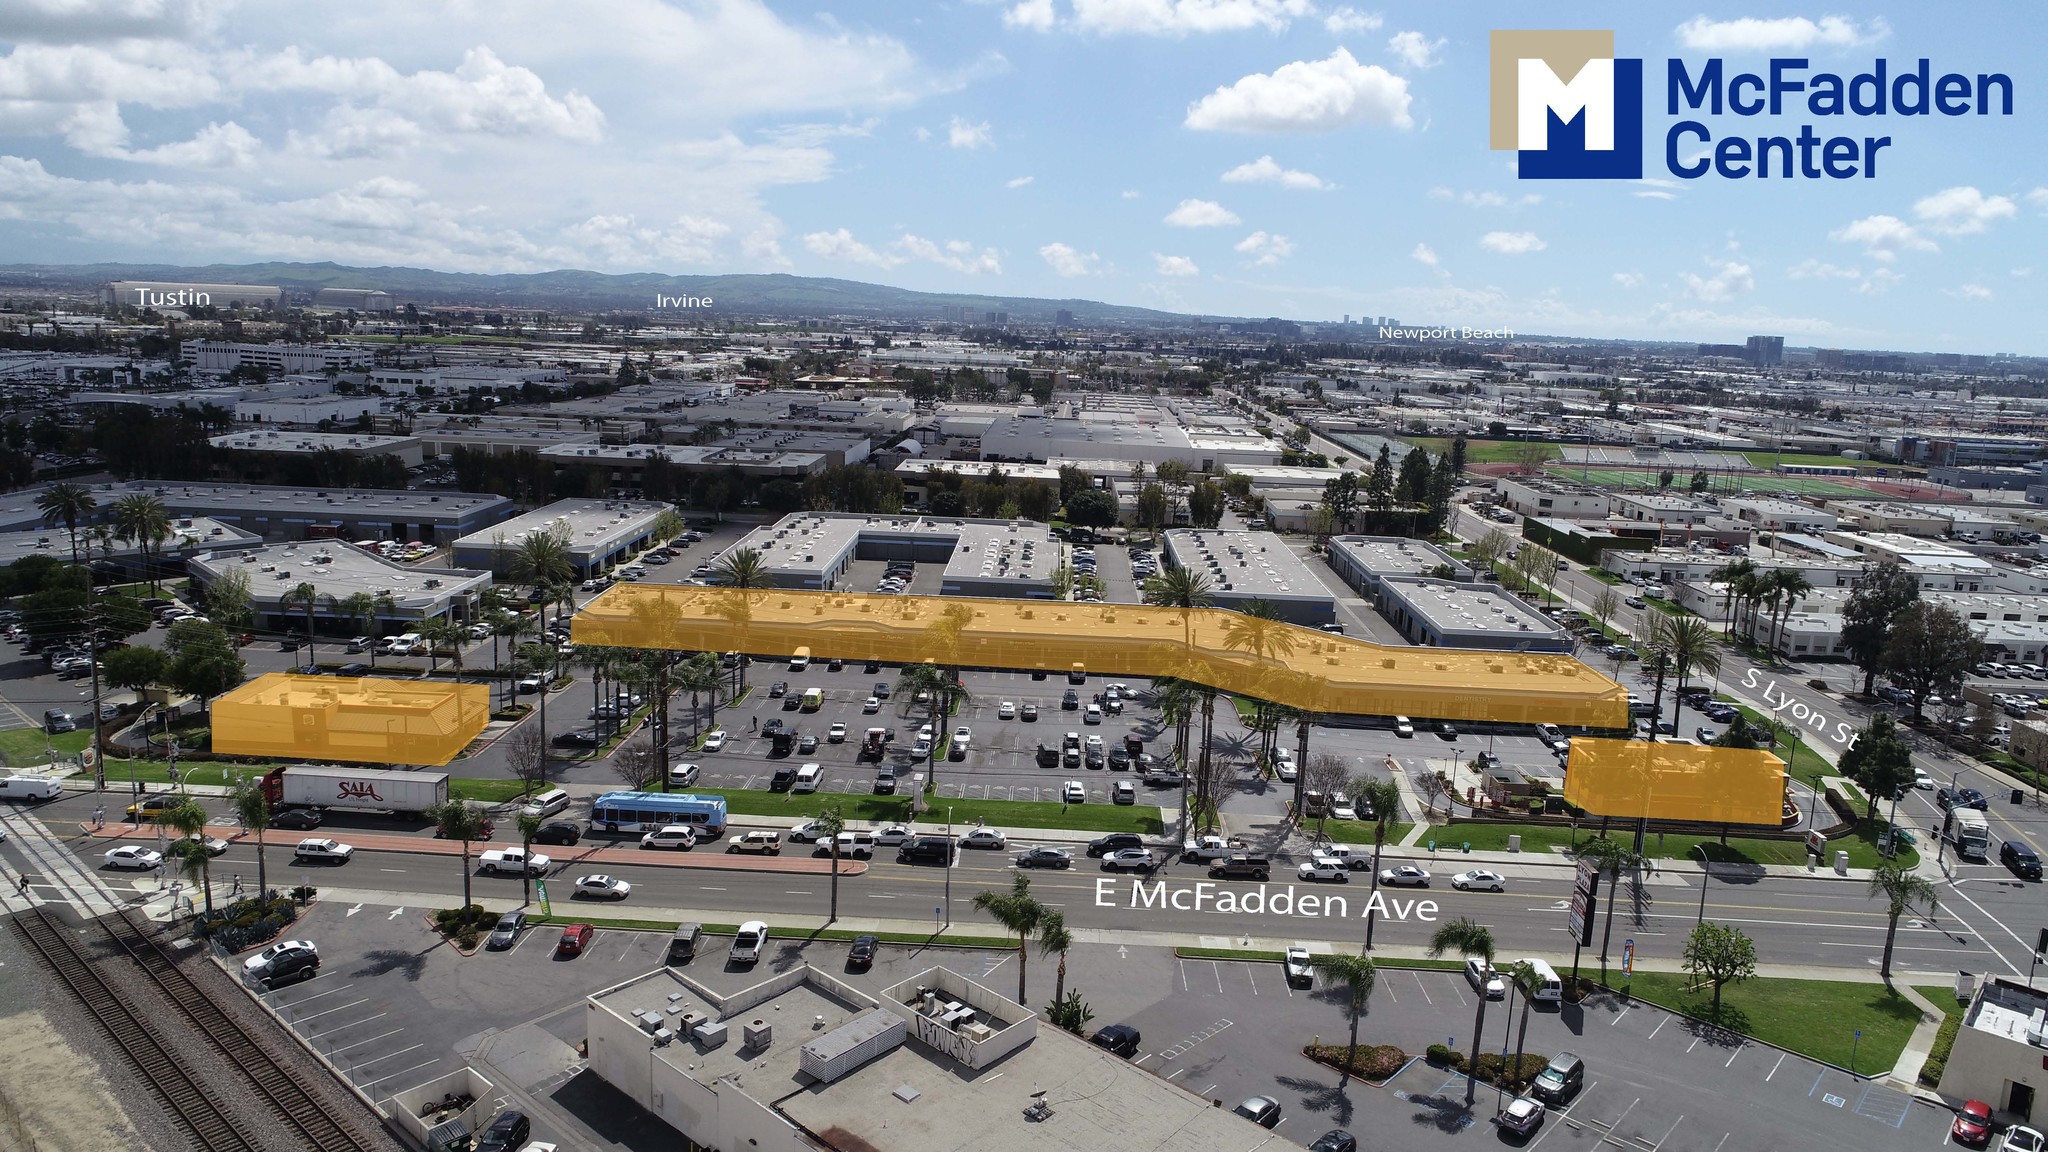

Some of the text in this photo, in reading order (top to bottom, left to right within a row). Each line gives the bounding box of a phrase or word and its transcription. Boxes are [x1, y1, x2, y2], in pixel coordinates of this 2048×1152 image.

[337, 782, 383, 801] SAIA
[1578, 863, 1592, 882] LYON
[1576, 875, 1591, 891] PLAZA
